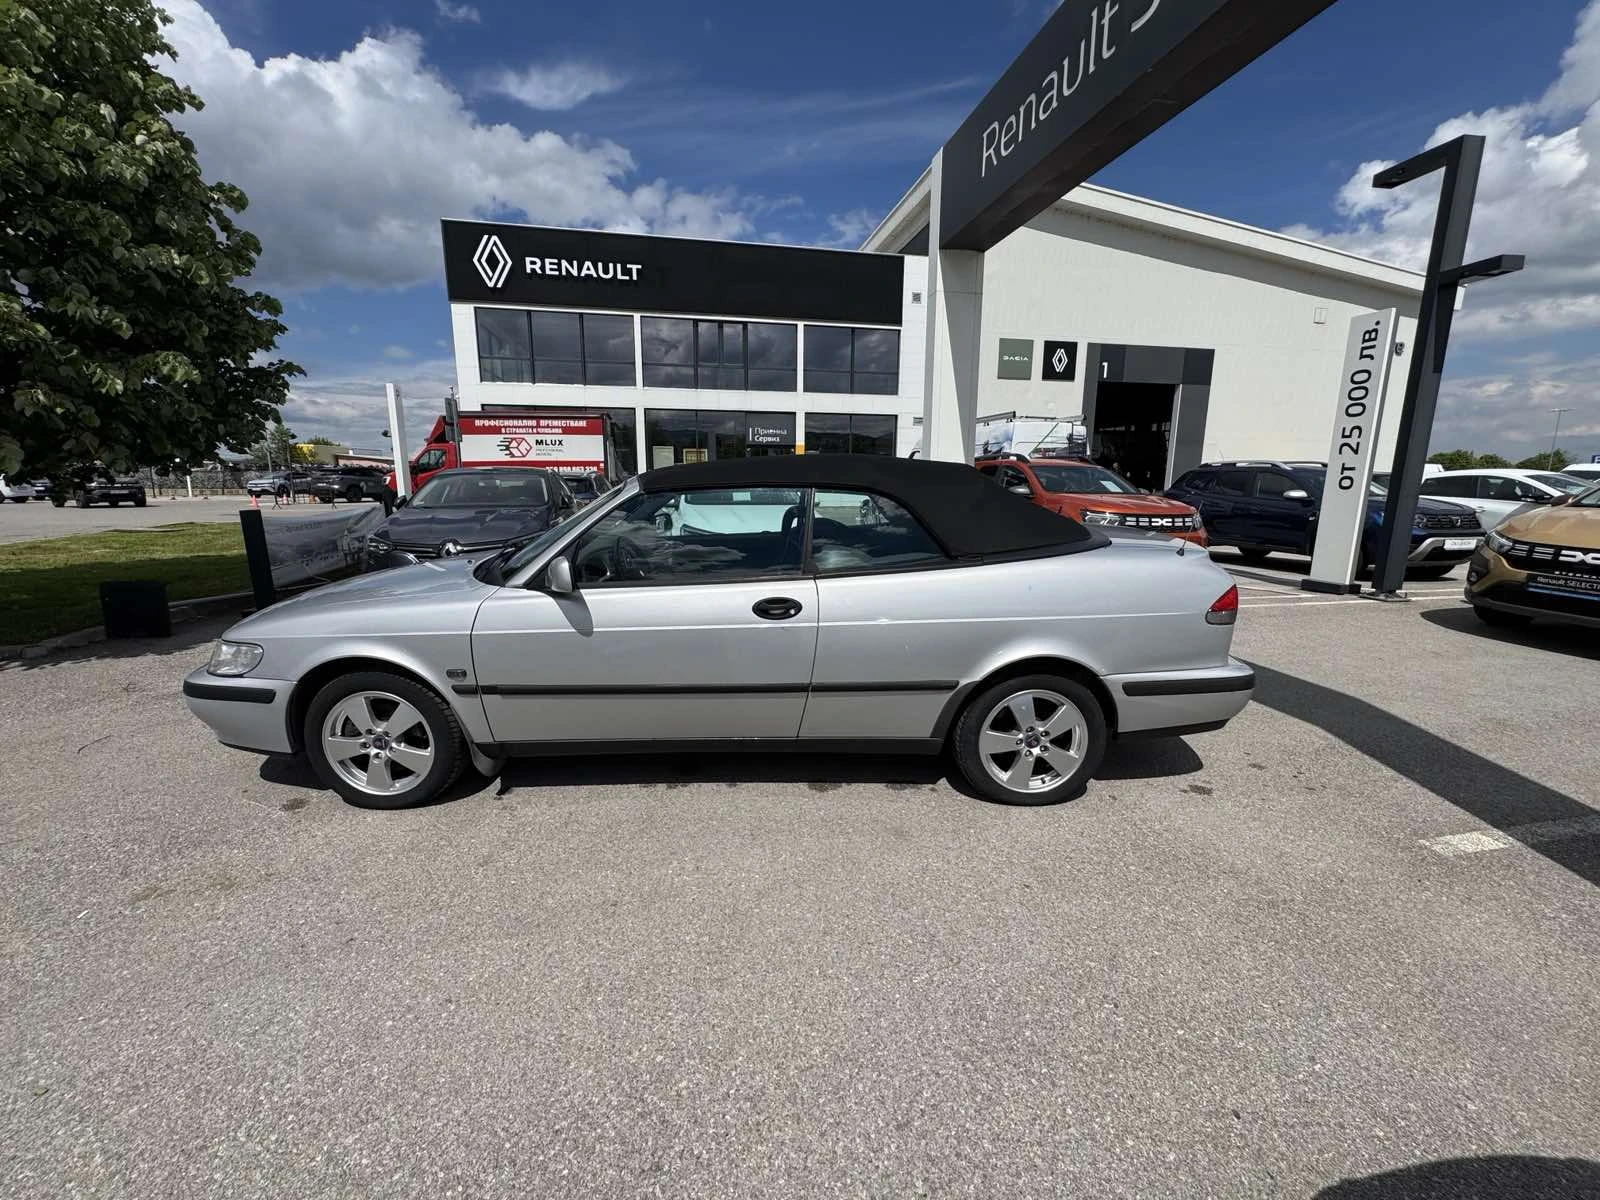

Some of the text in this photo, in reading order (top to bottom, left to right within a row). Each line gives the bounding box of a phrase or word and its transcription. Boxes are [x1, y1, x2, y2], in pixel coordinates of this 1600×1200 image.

[980, 0, 1119, 178] Renault
[525, 256, 642, 280] RENAULT
[1101, 361, 1109, 379] 1
[1345, 369, 1372, 418] 000
[535, 439, 564, 447] MLUX
[1339, 425, 1363, 455] 25
